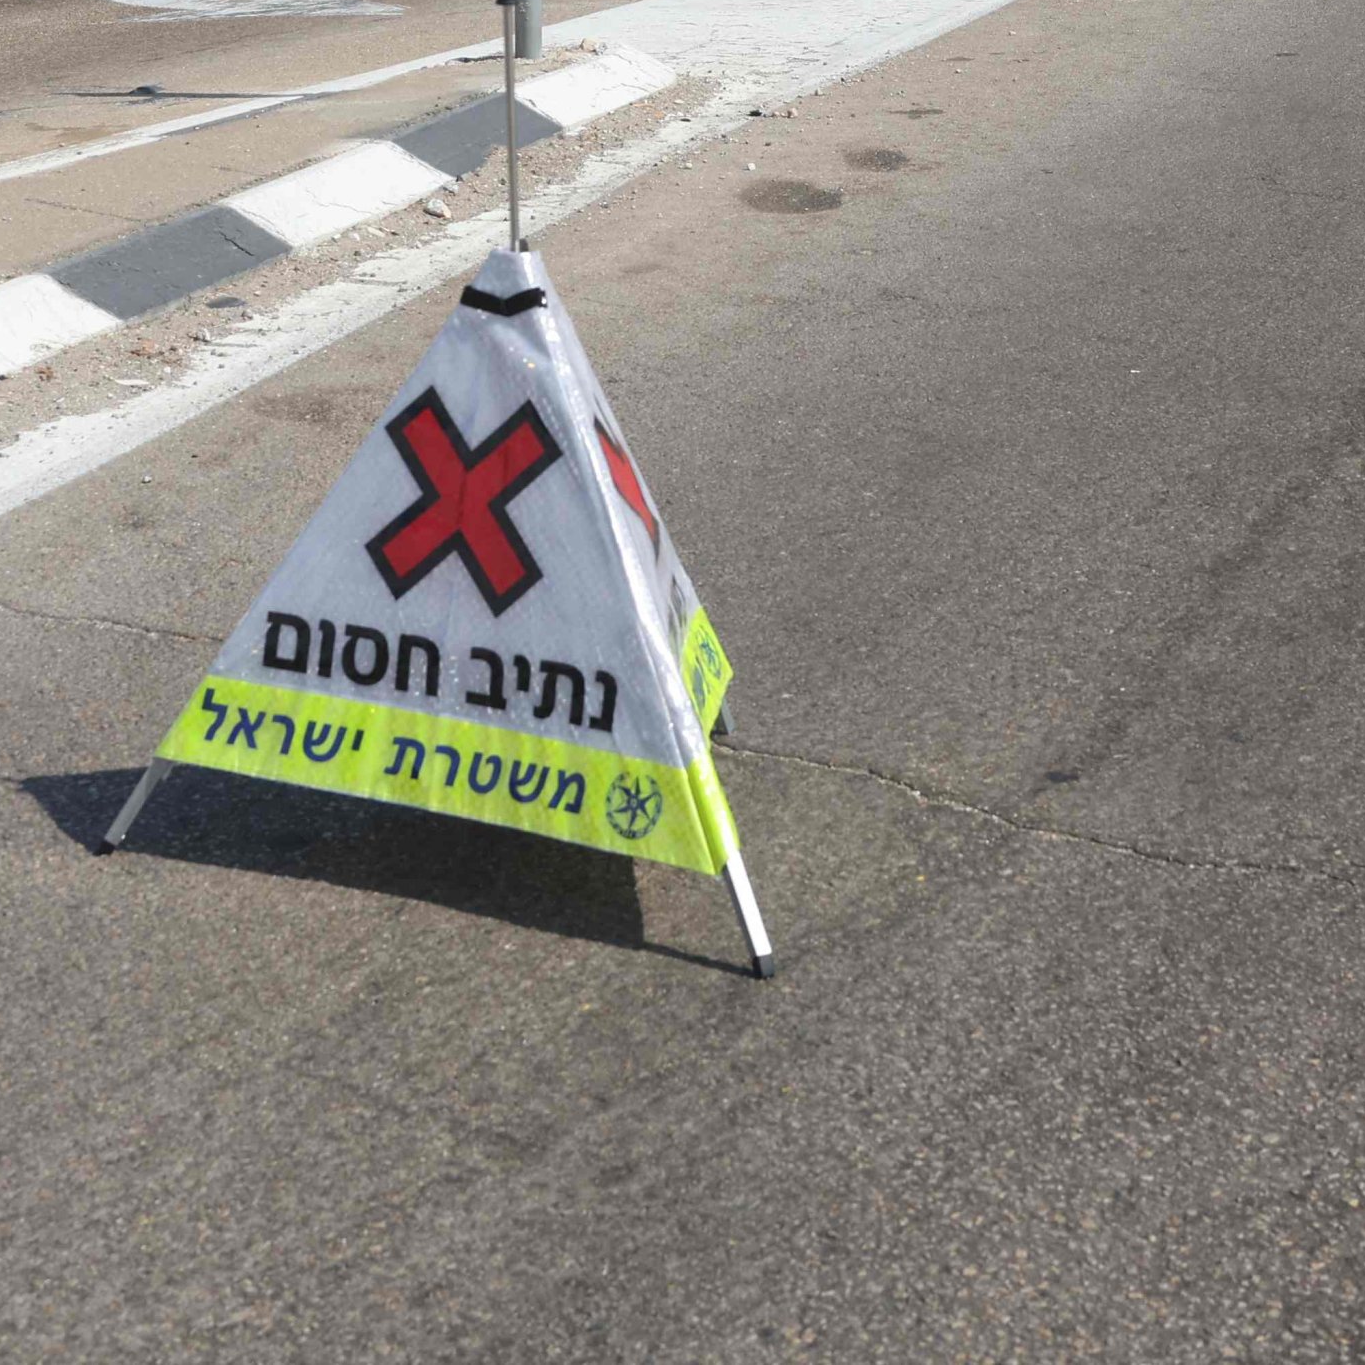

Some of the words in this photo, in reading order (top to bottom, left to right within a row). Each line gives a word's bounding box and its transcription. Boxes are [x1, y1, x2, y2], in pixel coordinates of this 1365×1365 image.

[262, 611, 441, 696] חסום
[466, 646, 618, 733] נתיב
[200, 688, 364, 761] ישראל
[384, 736, 586, 813] משטרת
